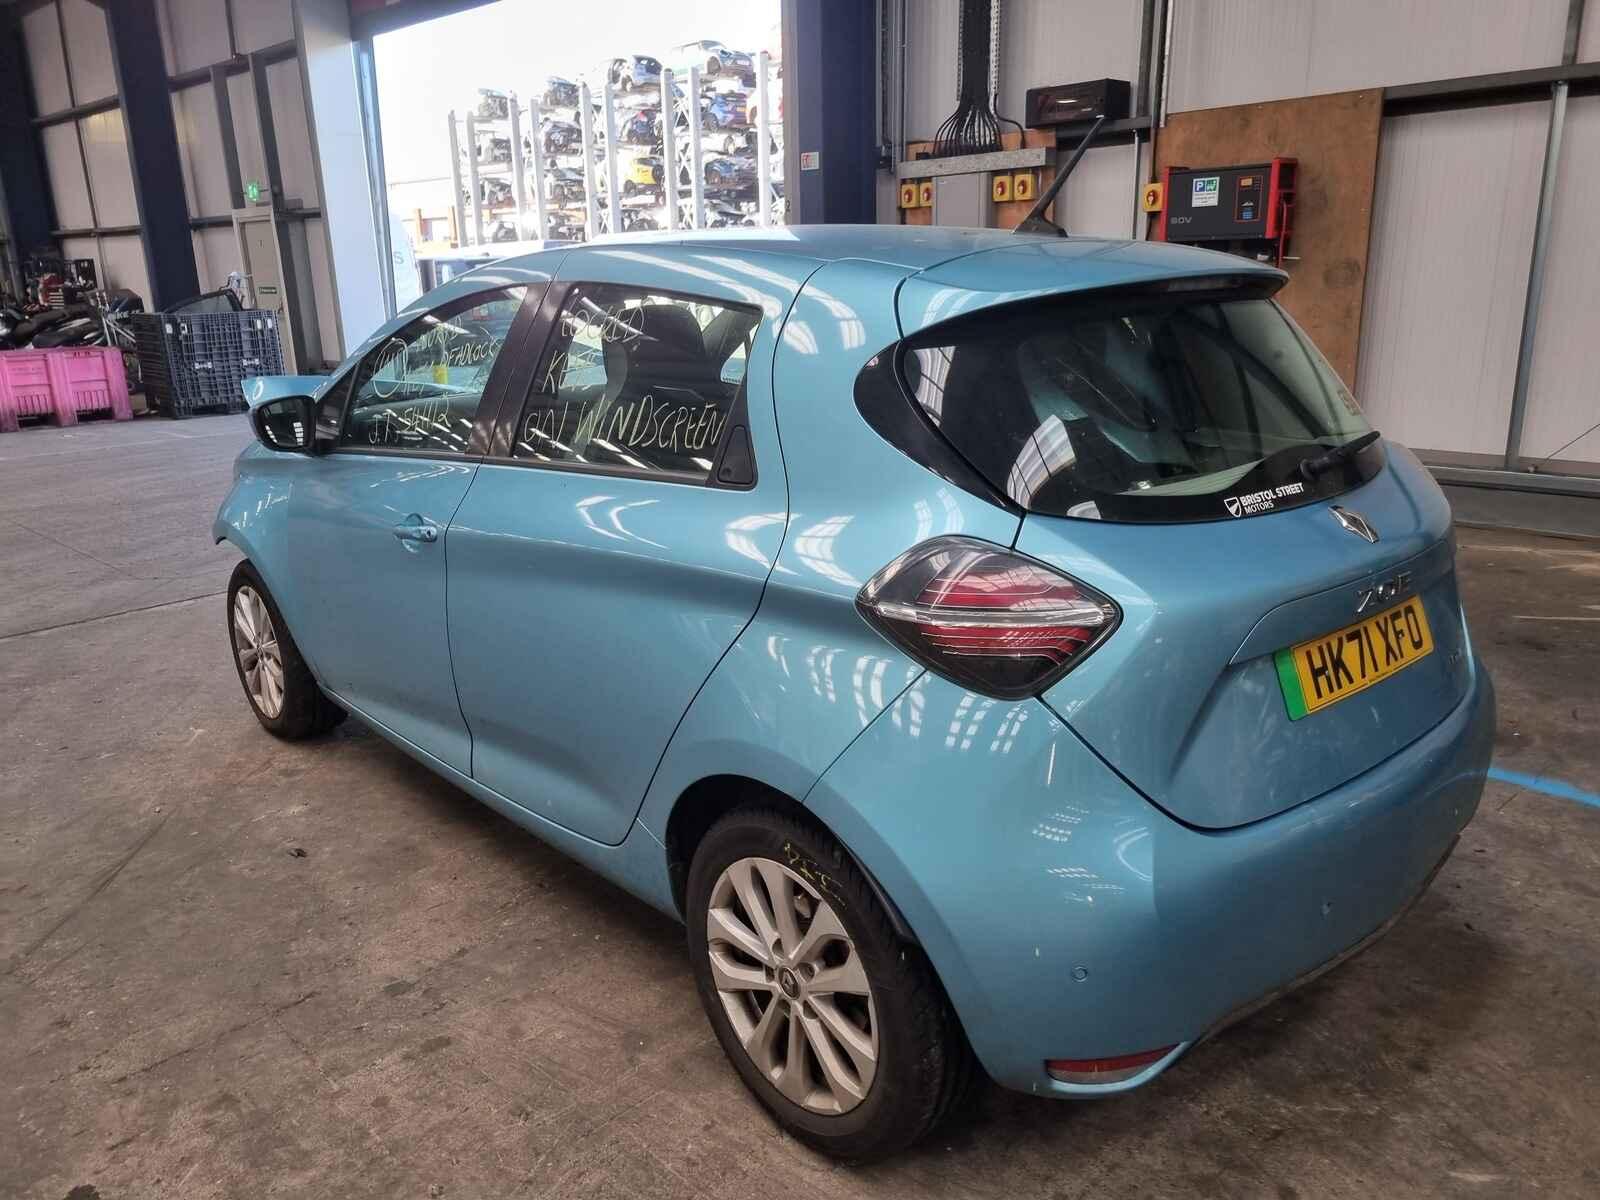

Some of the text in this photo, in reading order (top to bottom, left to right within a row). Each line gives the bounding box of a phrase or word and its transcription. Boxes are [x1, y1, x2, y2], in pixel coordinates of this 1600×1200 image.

[574, 393, 727, 453] WINDSCREEN
[1240, 482, 1304, 506] BRISTOL STREET
[1244, 500, 1274, 514] MOTORS
[1305, 604, 1424, 699] HK71 XFO
